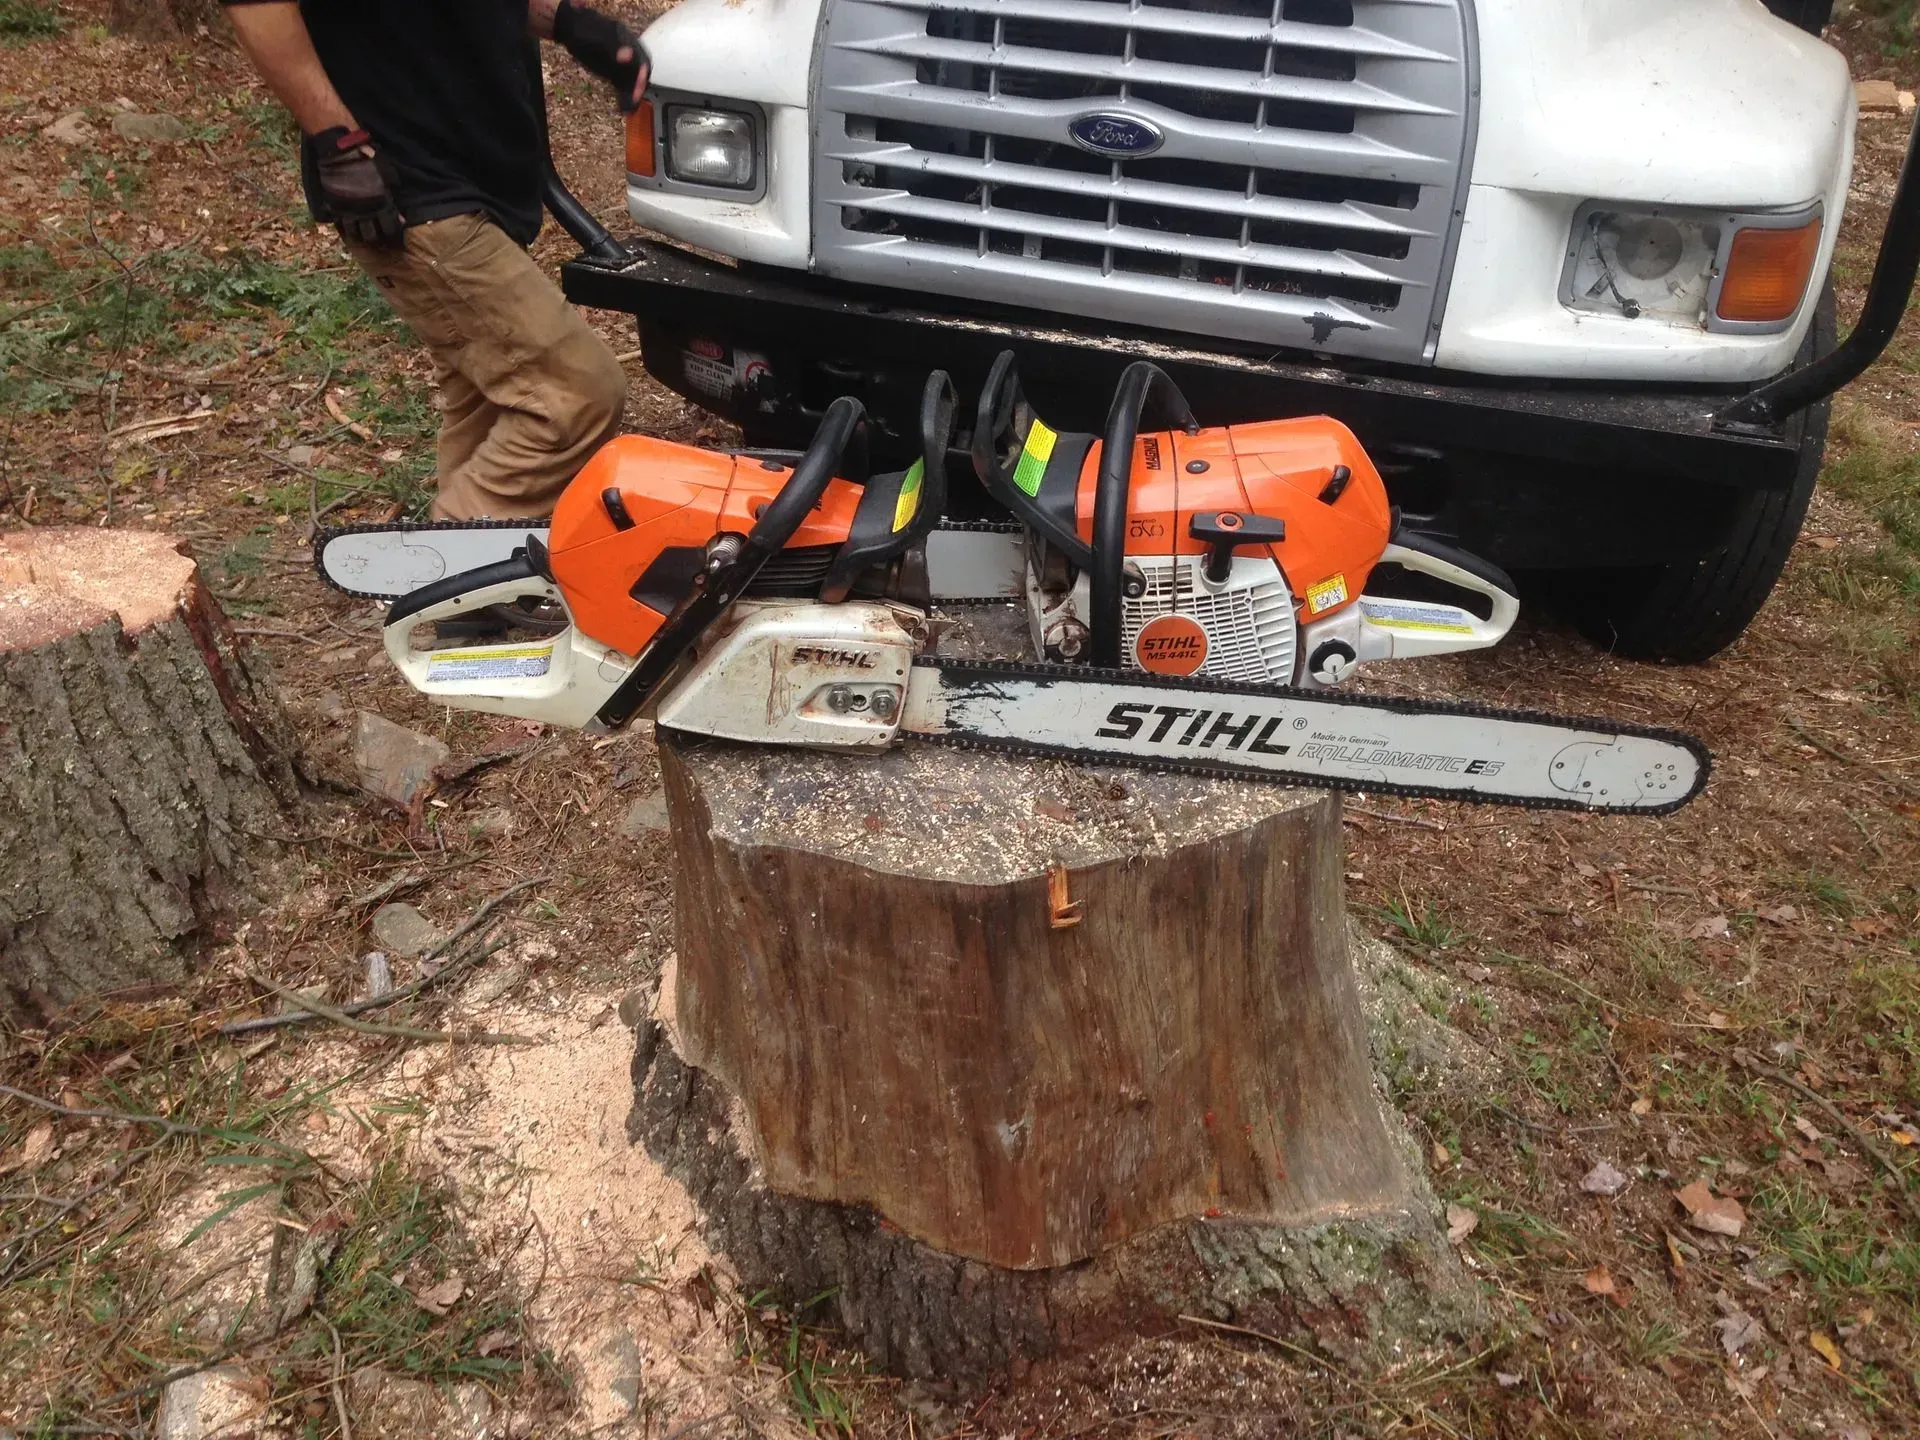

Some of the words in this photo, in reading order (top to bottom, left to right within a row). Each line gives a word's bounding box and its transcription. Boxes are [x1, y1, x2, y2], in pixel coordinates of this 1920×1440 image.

[1090, 120, 1139, 146] Ford
[1143, 437, 1159, 470] MAGNUM
[1143, 636, 1201, 650] STIHL
[792, 646, 876, 668] STIHL
[1095, 702, 1290, 755] STIHL
[1310, 731, 1336, 742] Made
[1337, 734, 1347, 742] in
[1348, 735, 1390, 747] Germany
[1298, 742, 1466, 773] ROLLOMATIC
[1464, 759, 1505, 776] ES
